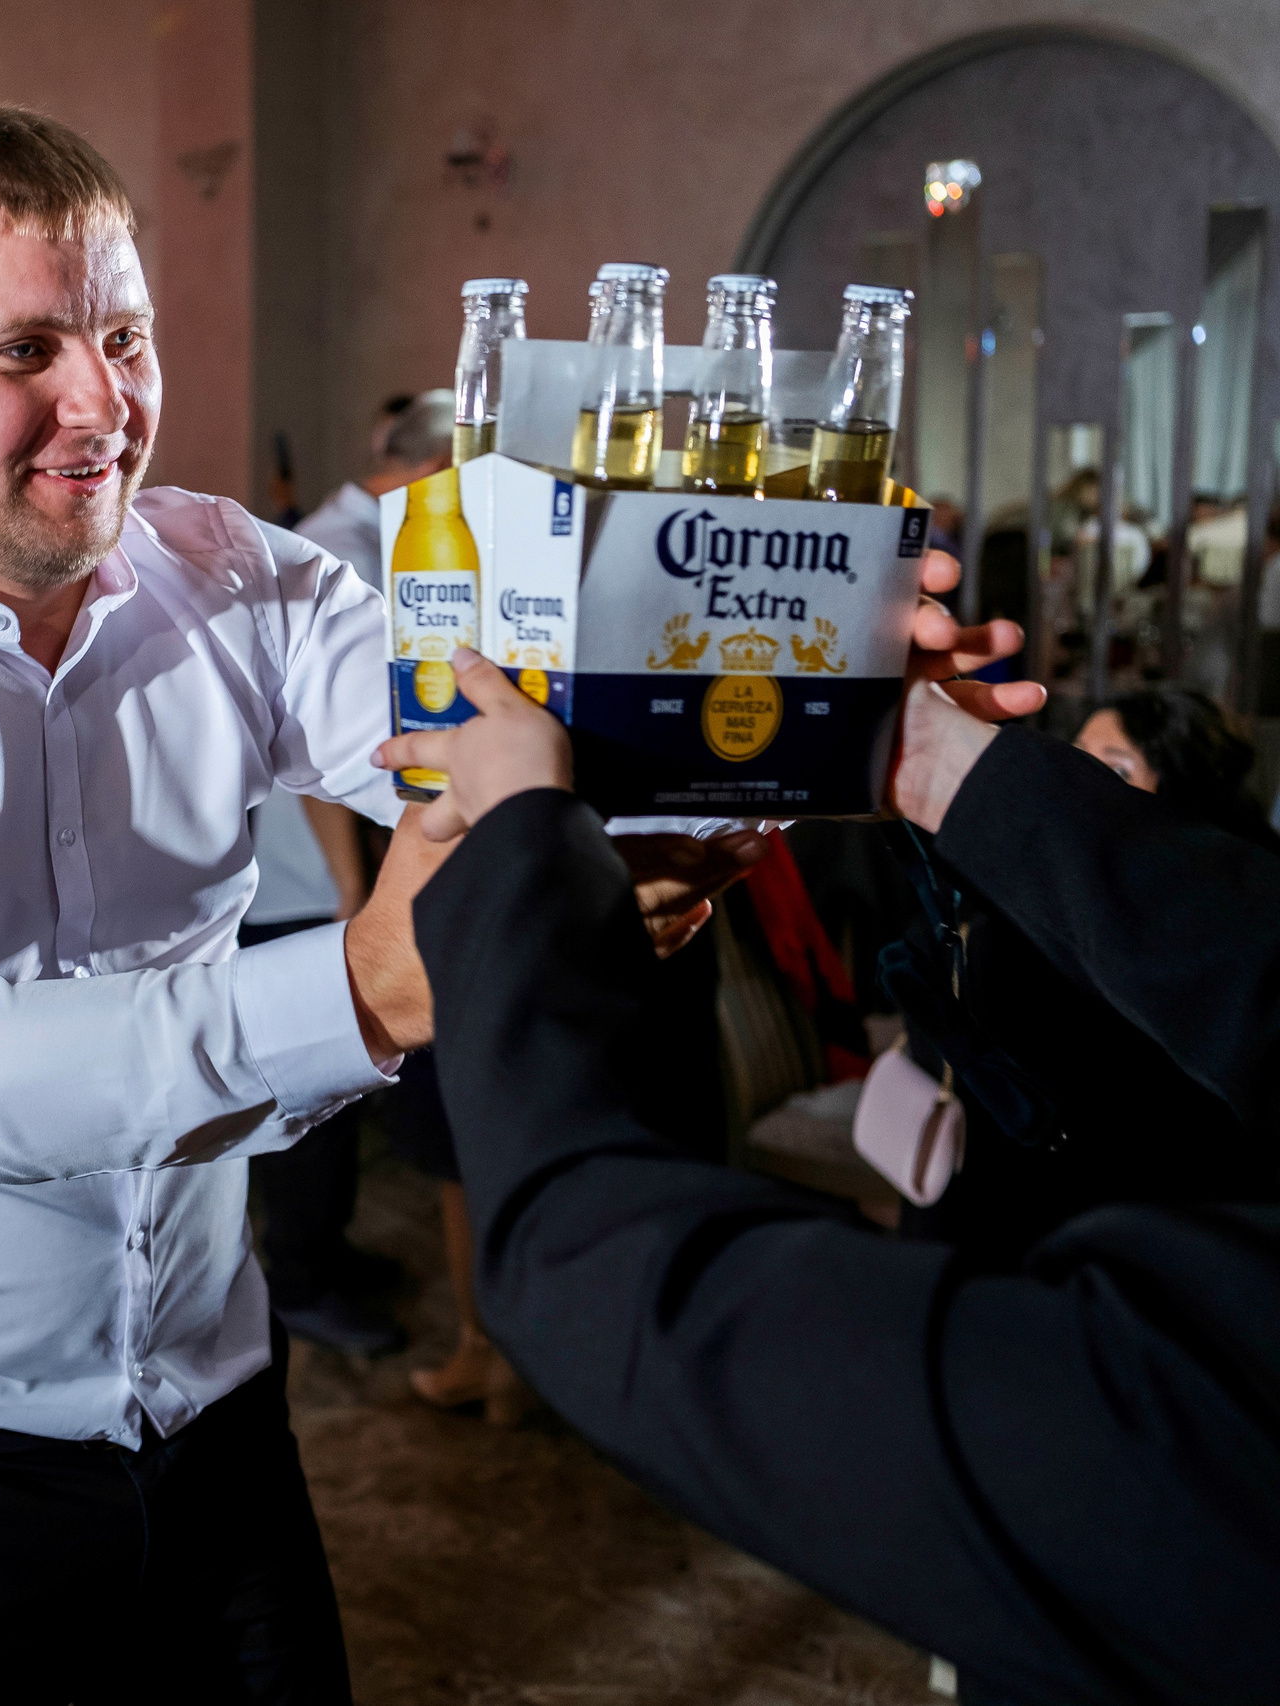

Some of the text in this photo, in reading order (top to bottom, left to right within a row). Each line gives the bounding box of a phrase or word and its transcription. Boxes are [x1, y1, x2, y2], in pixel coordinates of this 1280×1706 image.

[557, 491, 570, 516] 6
[908, 517, 921, 538] 6
[656, 508, 850, 580] Corona
[399, 577, 473, 608] Corona
[500, 588, 563, 621] Corona
[706, 574, 807, 621] Extra
[416, 606, 458, 626] Extra
[734, 686, 753, 698] LA
[711, 700, 773, 713] CERVEZA
